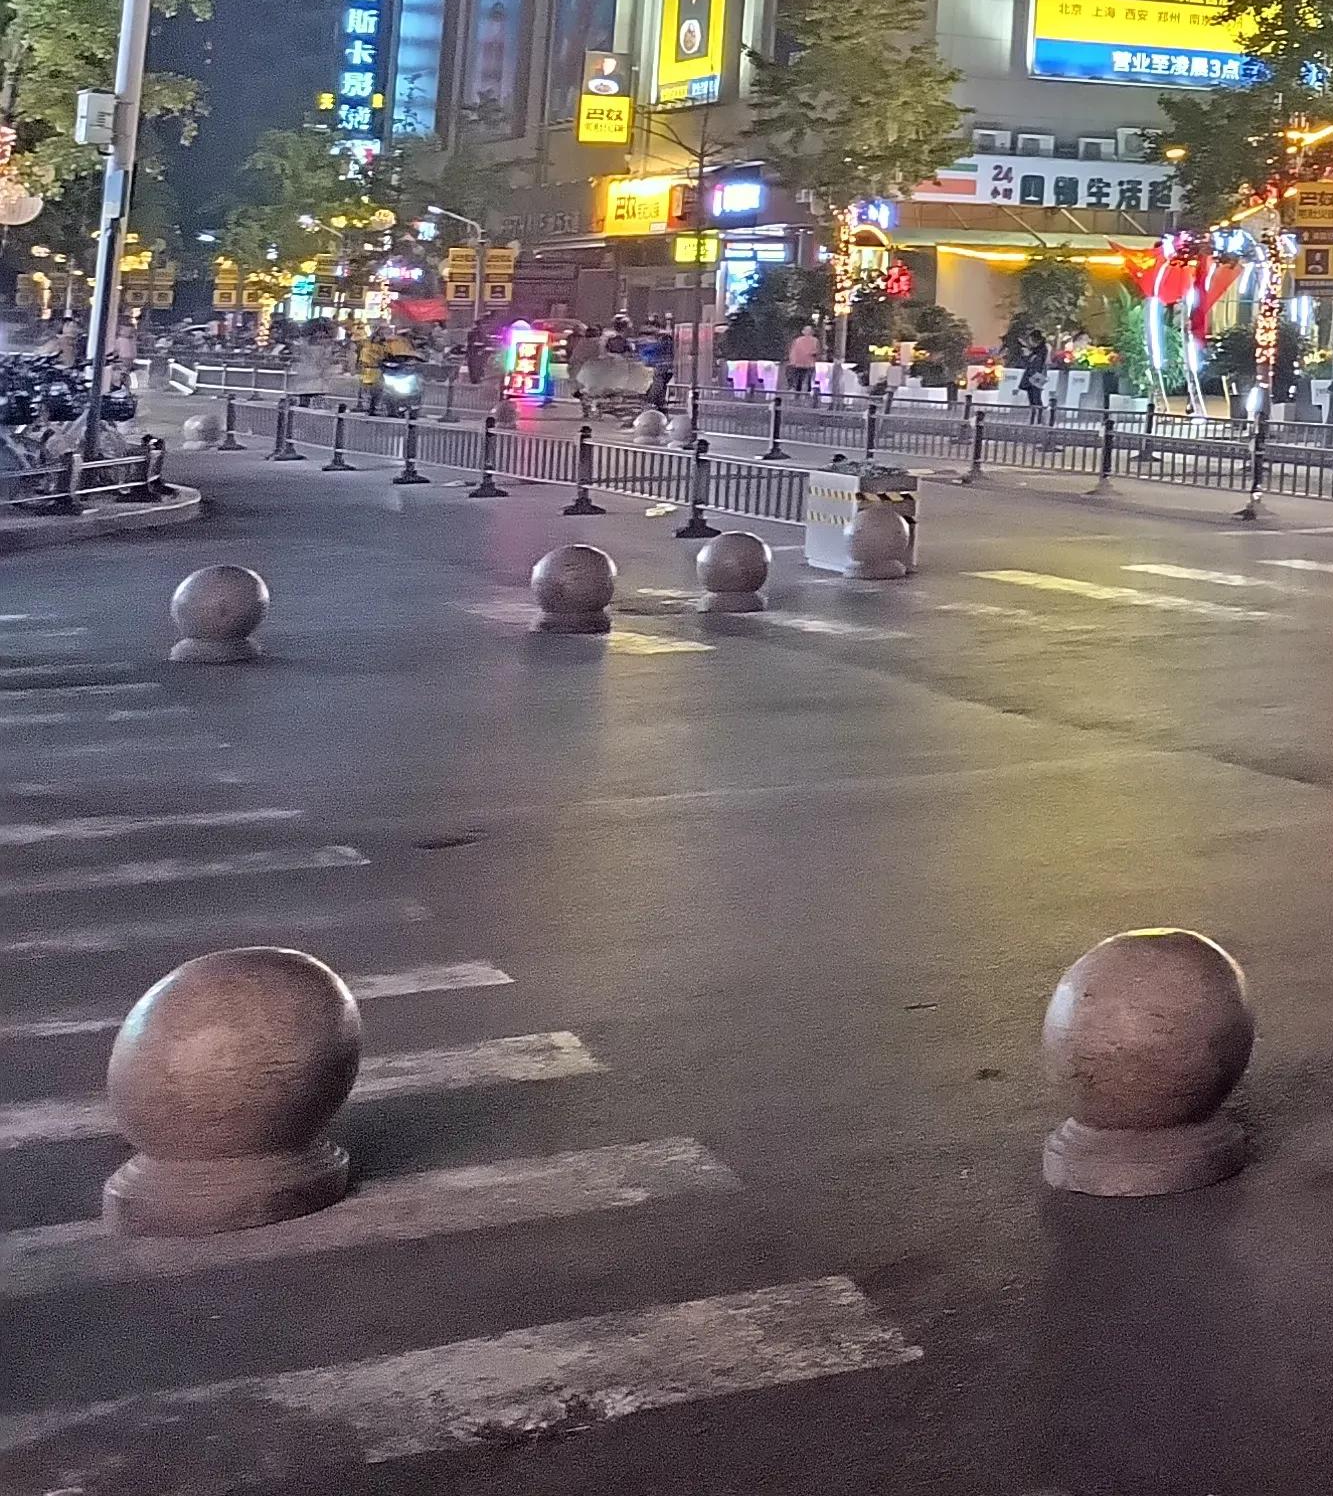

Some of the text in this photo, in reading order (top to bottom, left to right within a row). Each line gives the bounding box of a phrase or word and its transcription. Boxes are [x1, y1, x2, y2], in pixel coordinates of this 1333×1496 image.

[1058, 3, 1083, 17] 北京
[1092, 6, 1116, 19] 上海
[1125, 9, 1149, 23] 西安
[1112, 50, 1241, 81] 营业至凌晨3点
[586, 107, 624, 122] 巴奴
[991, 164, 1014, 183] 24
[614, 195, 637, 220] 巴奴
